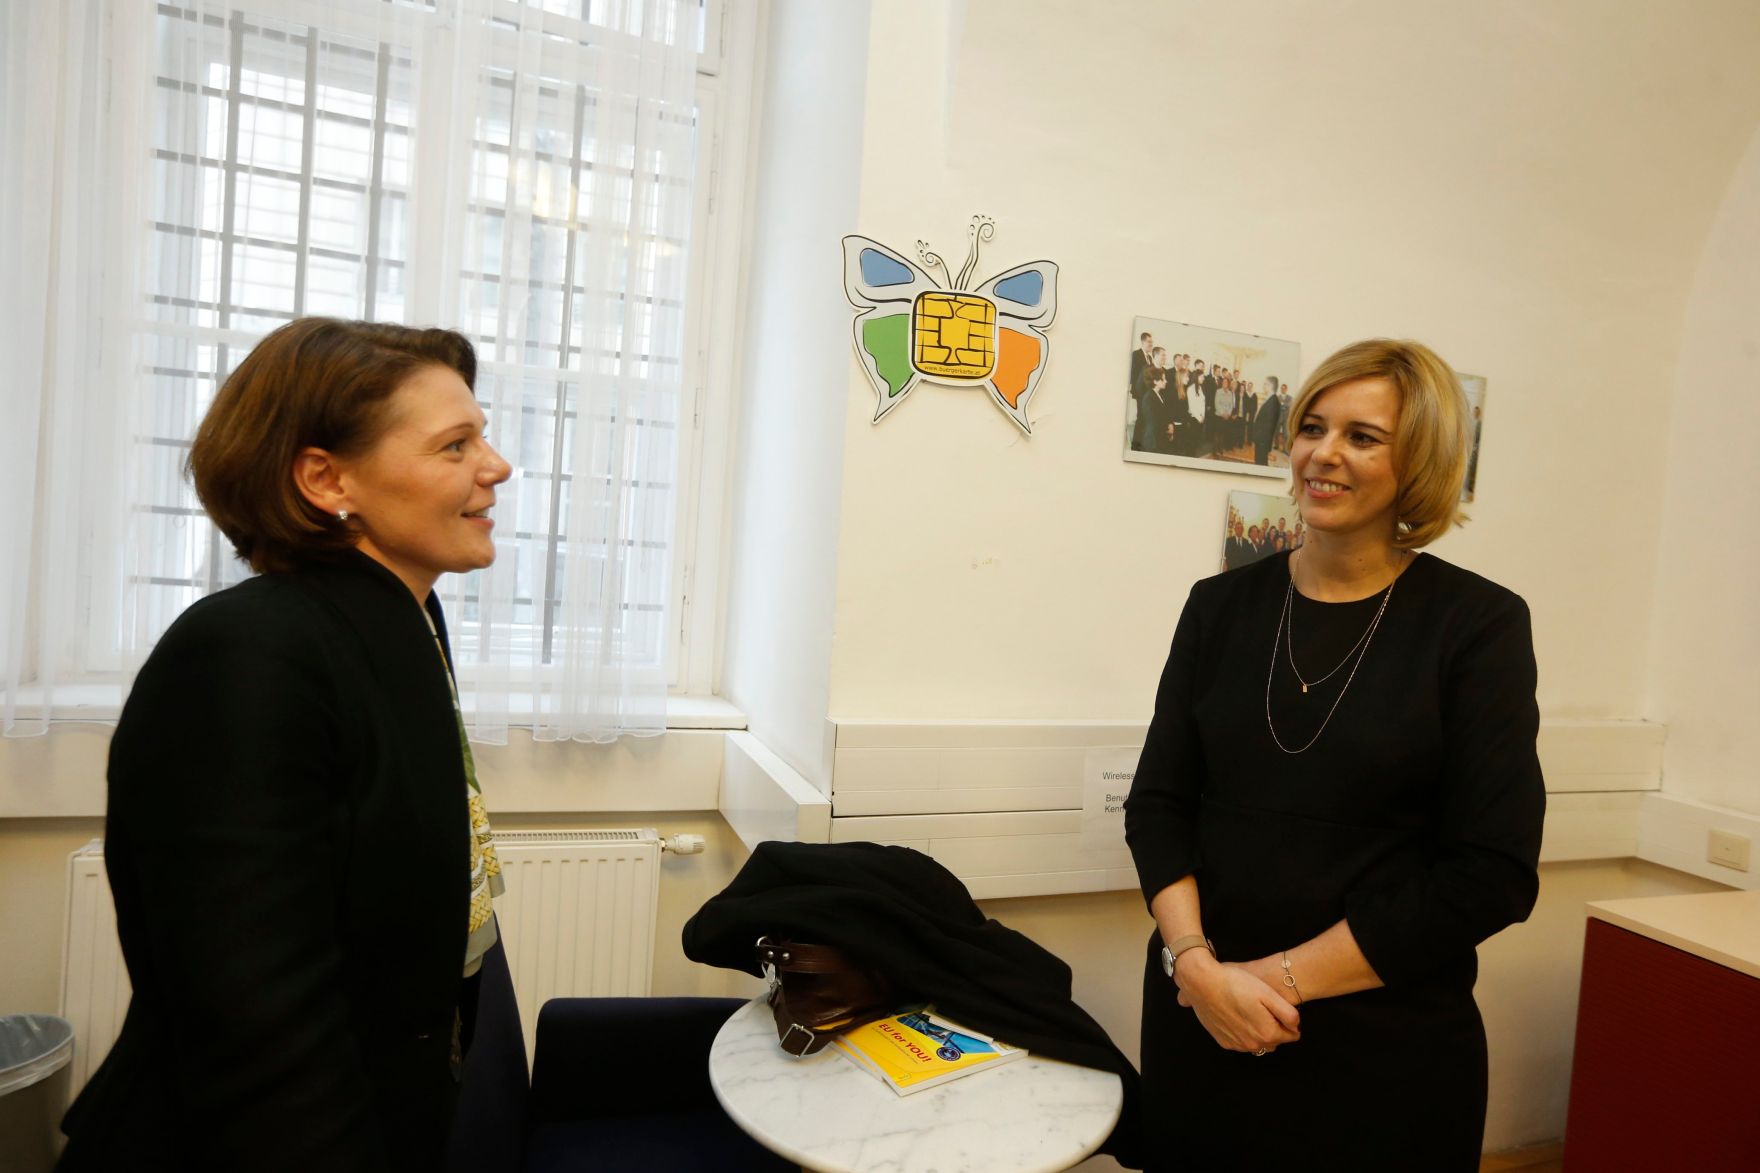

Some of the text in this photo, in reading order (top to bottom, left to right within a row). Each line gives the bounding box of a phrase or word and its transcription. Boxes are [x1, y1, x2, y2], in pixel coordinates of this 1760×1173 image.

[1103, 772, 1135, 780] Wireless
[878, 1023, 894, 1033] EU
[892, 1032, 906, 1042] for
[905, 1042, 933, 1063] YOU!
